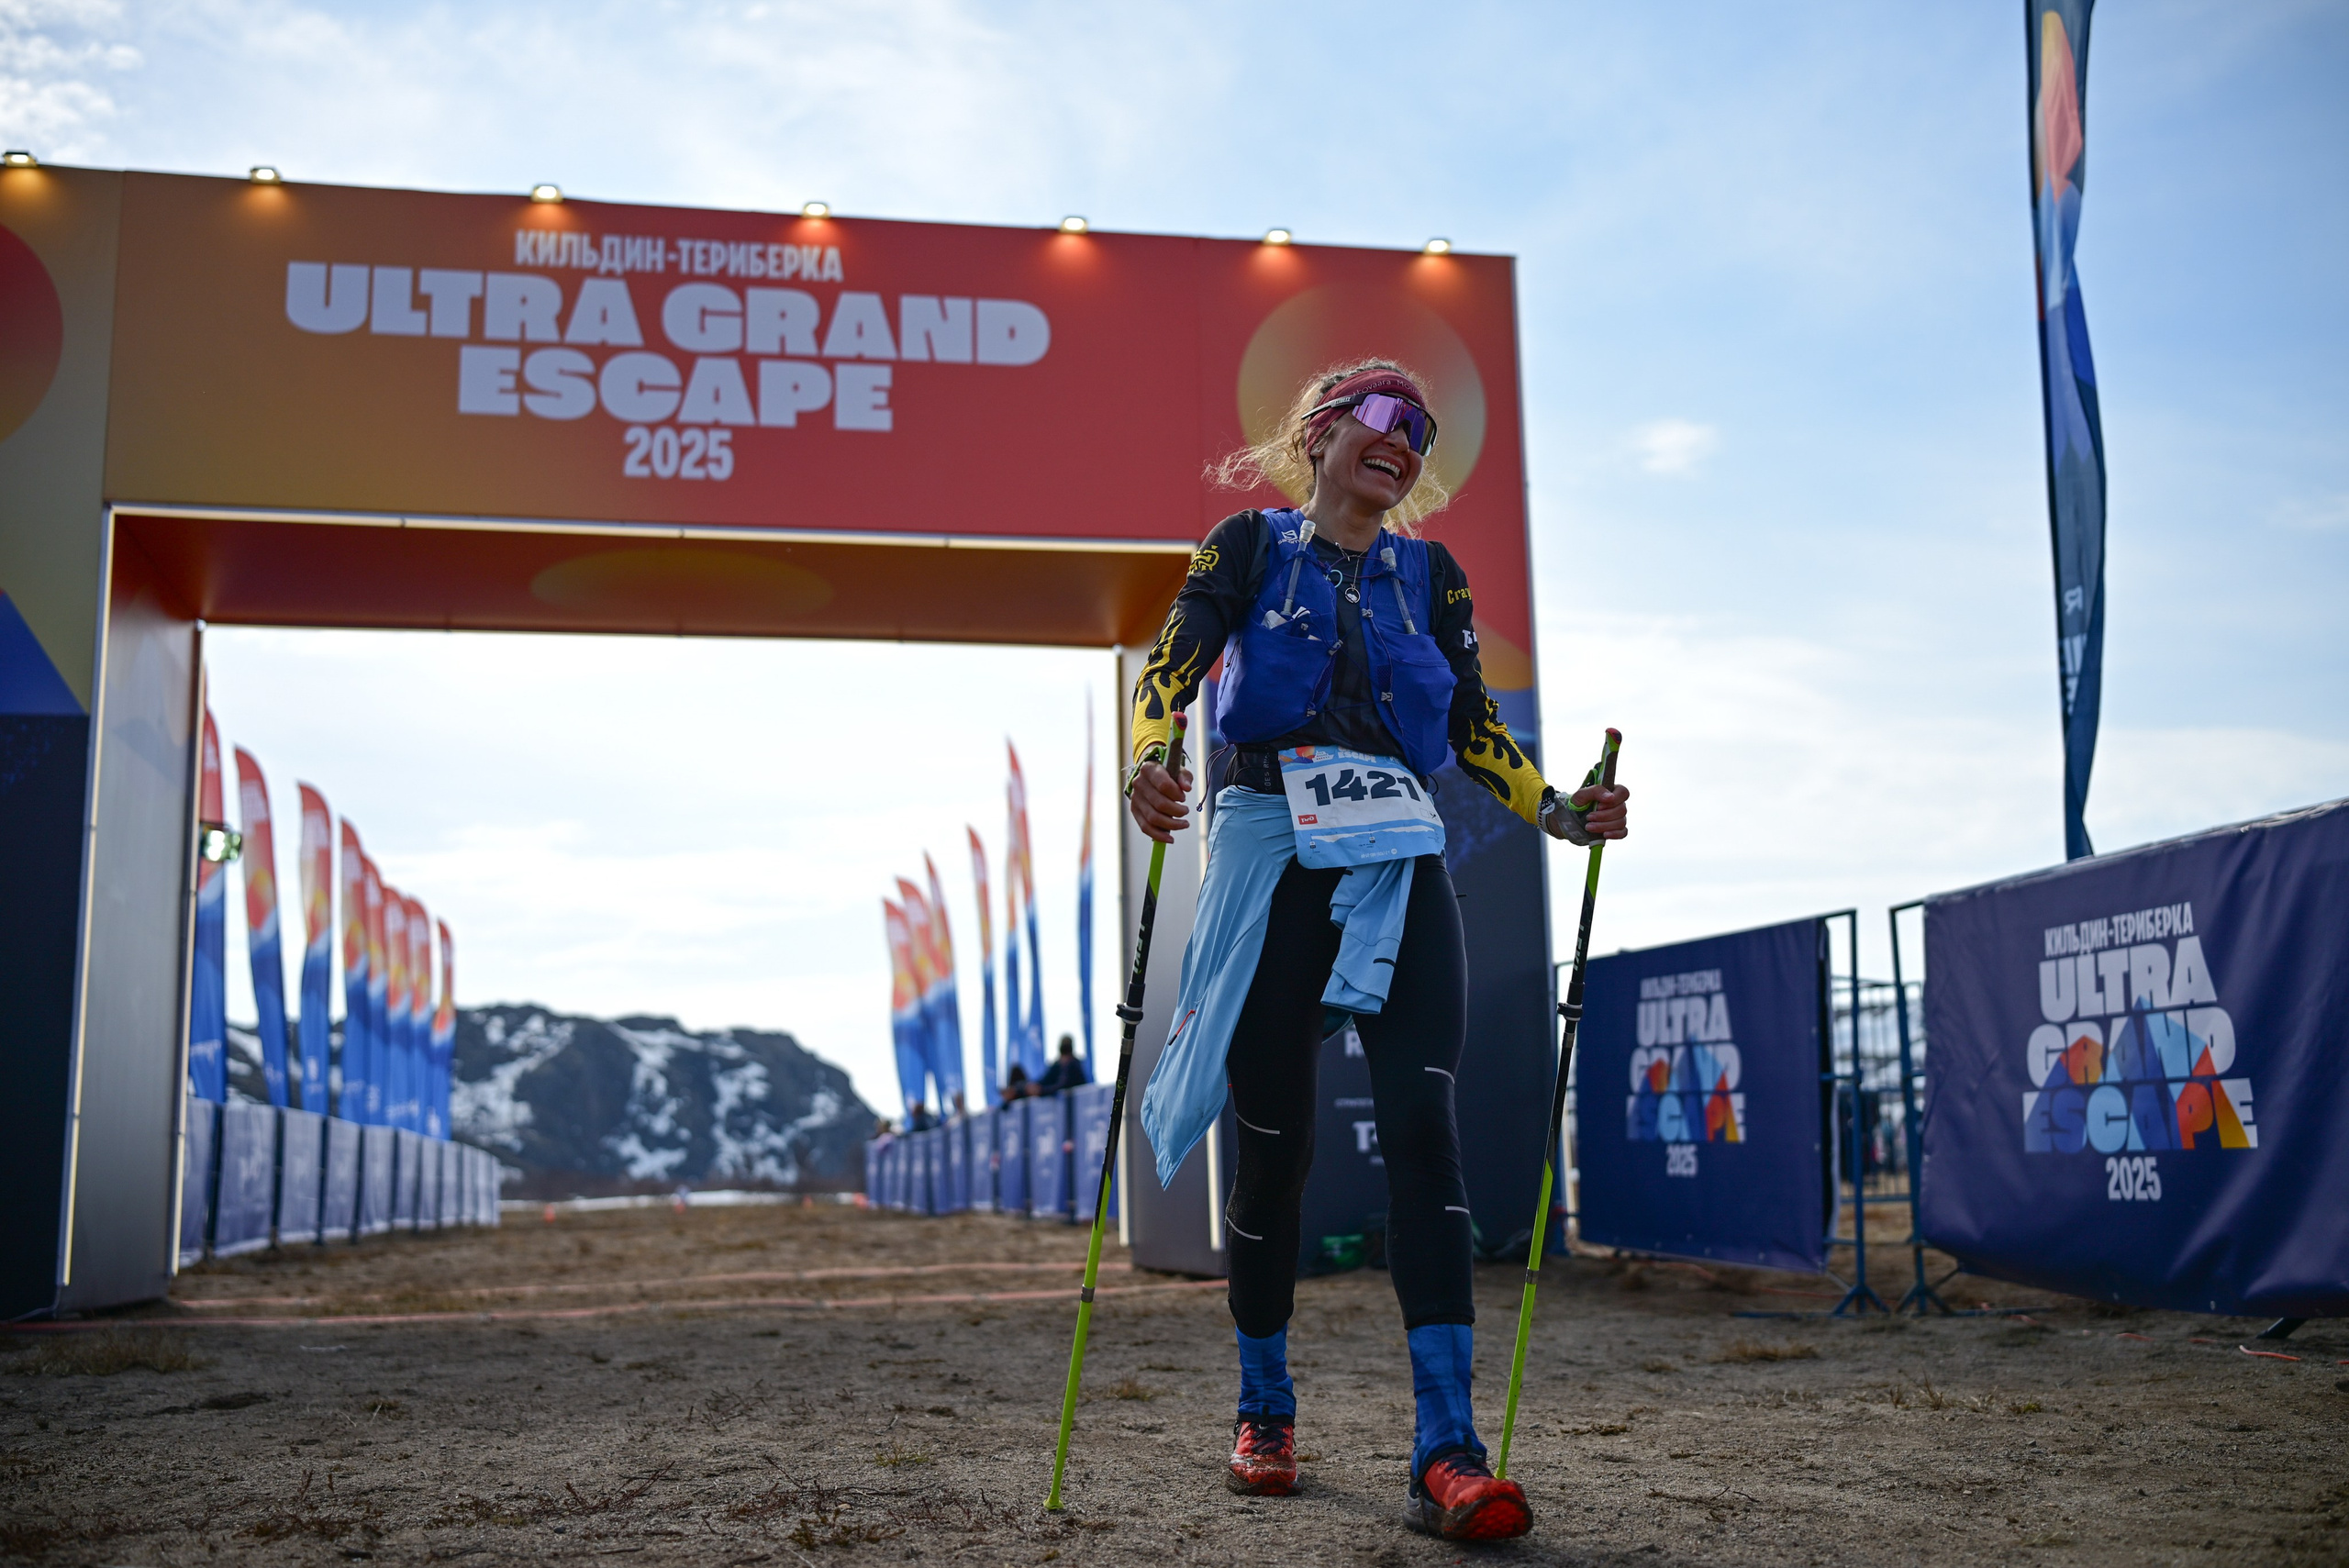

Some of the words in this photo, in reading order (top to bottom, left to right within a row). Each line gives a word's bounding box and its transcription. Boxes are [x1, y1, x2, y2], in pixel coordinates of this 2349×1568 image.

[517, 230, 843, 282] КИЛЬДИН-ТЕРИБЕРКА
[285, 261, 644, 346] ULTRA
[662, 284, 1051, 366] GRAND
[458, 345, 893, 431] ESCAPE
[623, 426, 733, 481] 2025
[1338, 751, 1376, 763] ESCAPE
[1305, 769, 1421, 806] 1421
[2044, 901, 2194, 958] КИЛЬДИН-ТЕРИБЕРКА
[2039, 935, 2218, 1023] ULTRA
[1637, 992, 1732, 1047] ULTRA
[1630, 1042, 1741, 1094] GRAND
[2027, 1006, 2235, 1089] GRAND
[1626, 1092, 1745, 1143] ESCAPE
[2023, 1078, 2258, 1154] ESCAPE
[1666, 1144, 1697, 1176] 2025
[2106, 1156, 2162, 1201] 2025
